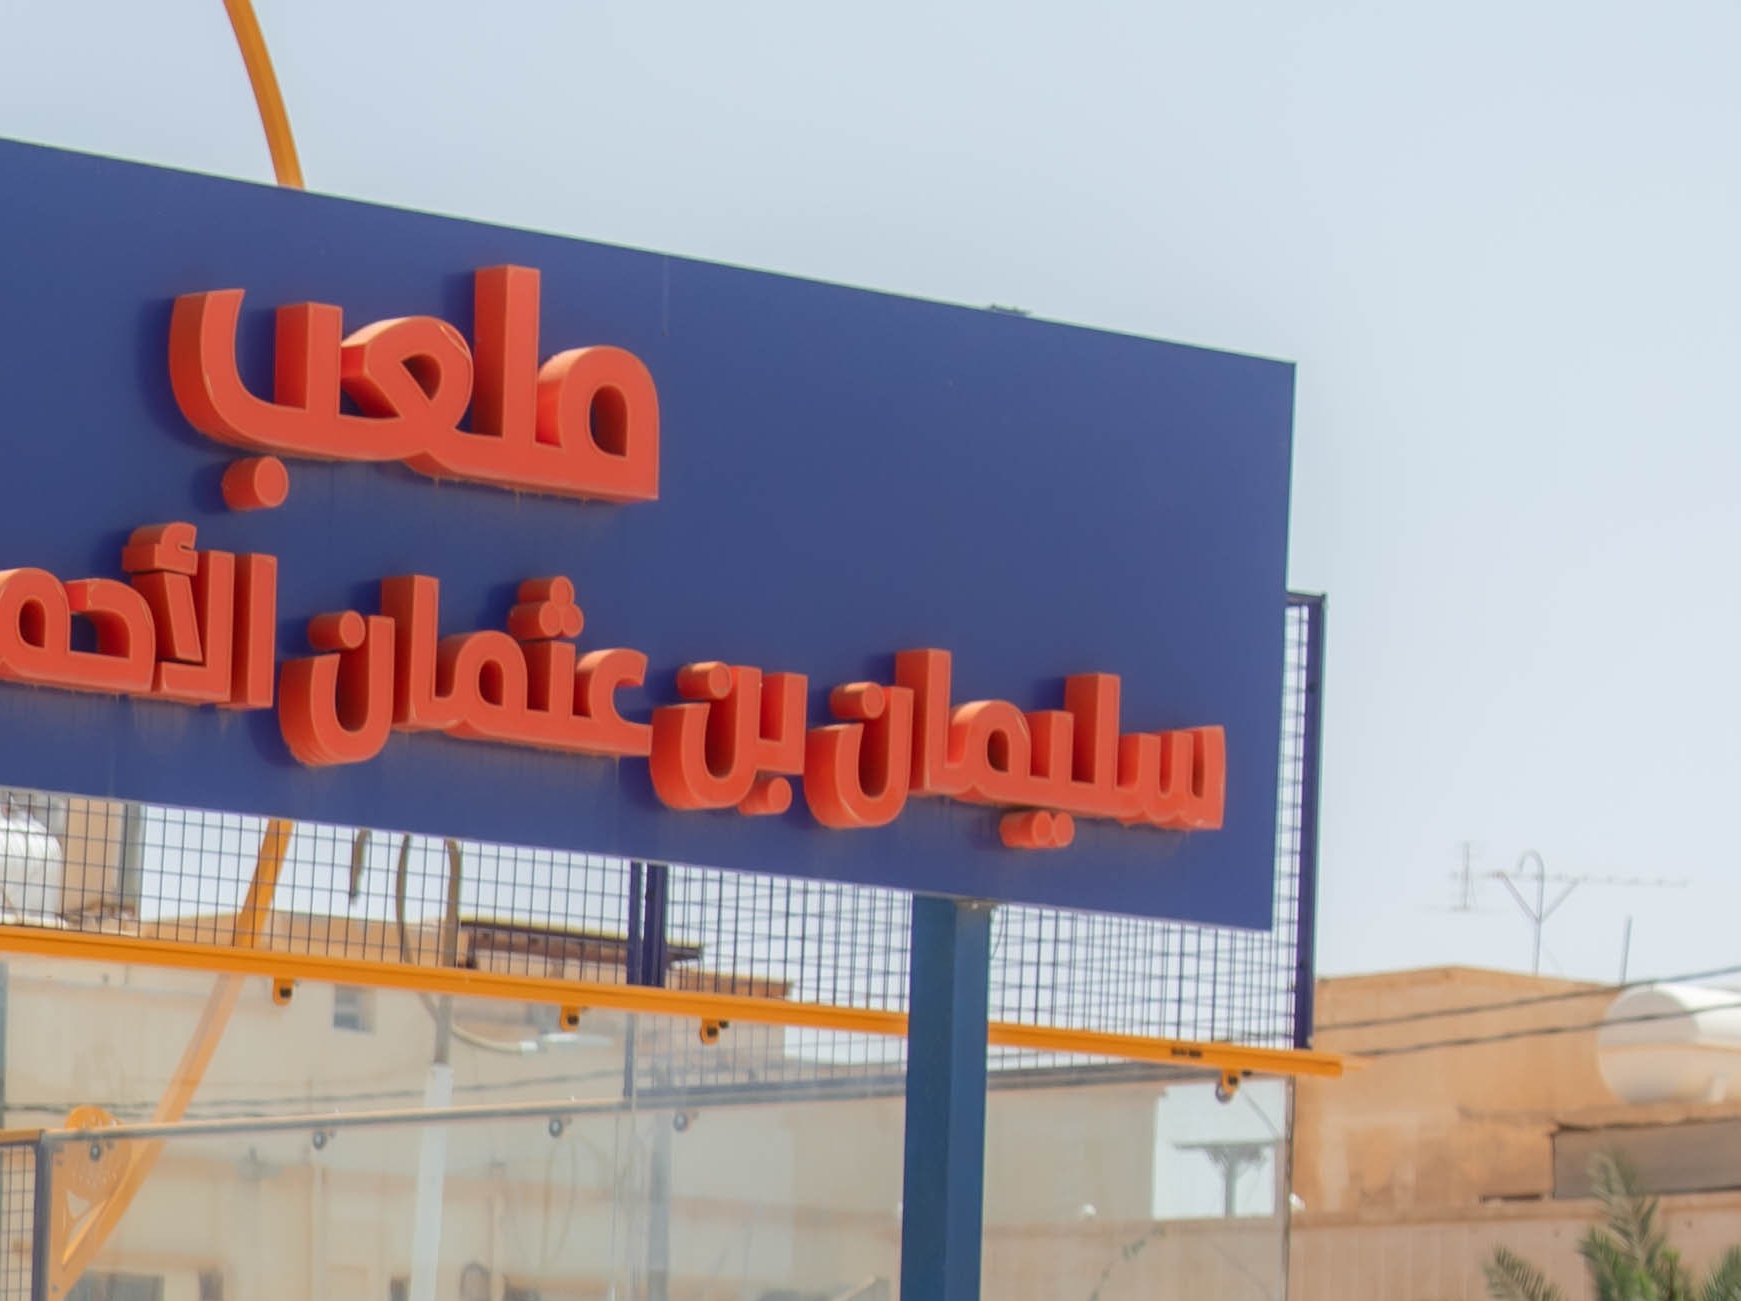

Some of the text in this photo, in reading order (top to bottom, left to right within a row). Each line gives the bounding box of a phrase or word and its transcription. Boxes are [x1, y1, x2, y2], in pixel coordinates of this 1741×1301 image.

[168, 264, 662, 513] ملعب
[278, 573, 654, 767] عثمان
[649, 658, 809, 818] بن
[804, 646, 1228, 851] سليمان
